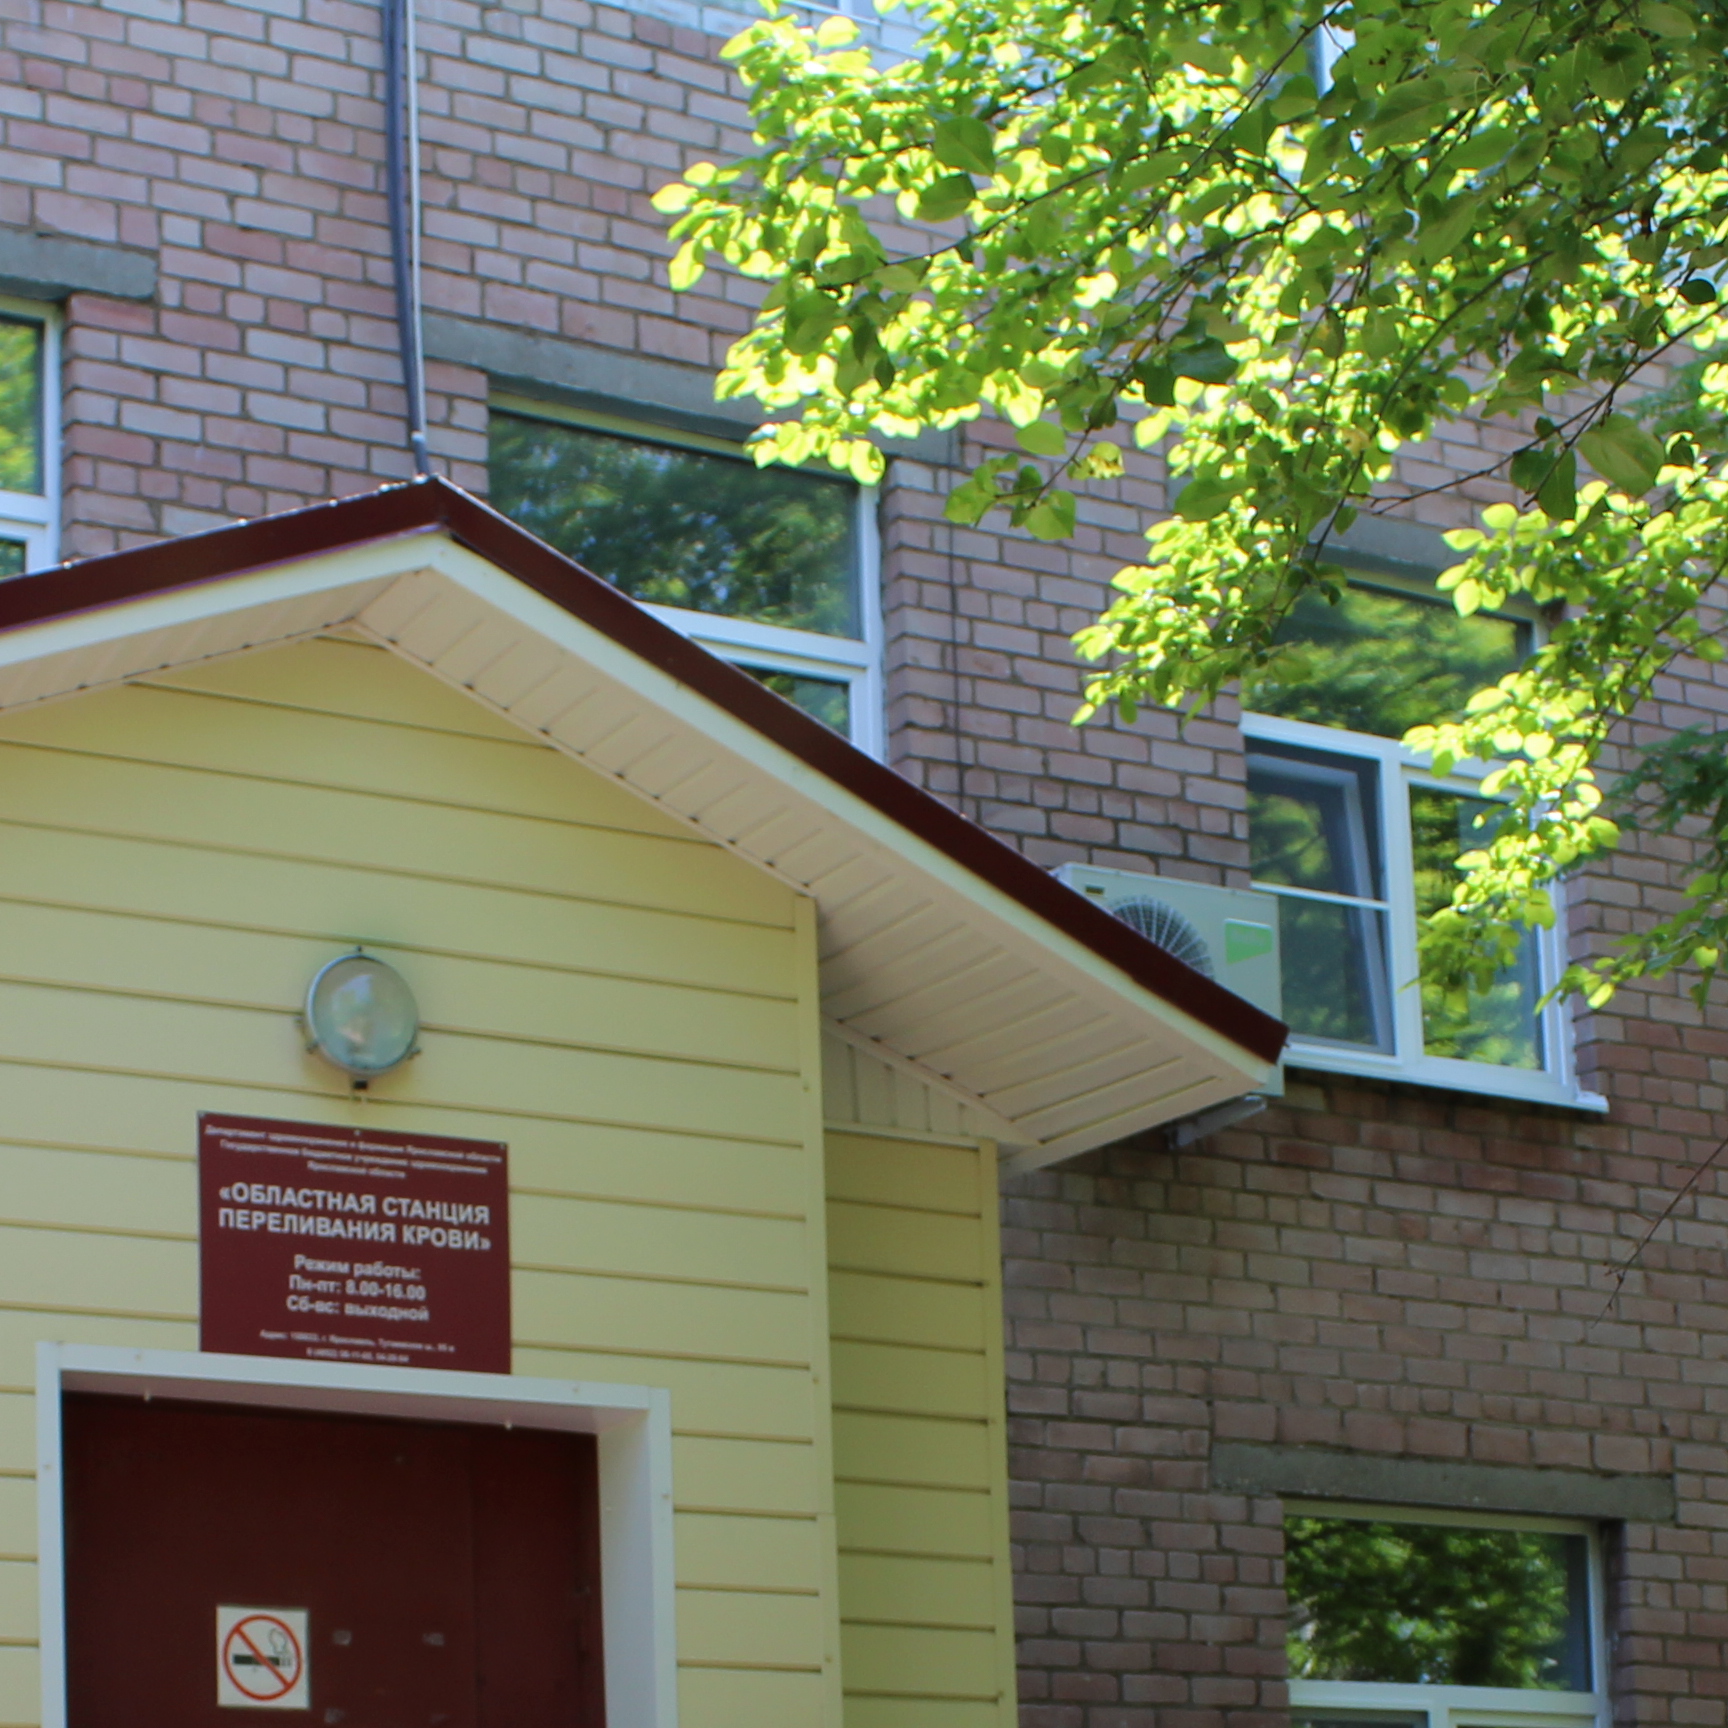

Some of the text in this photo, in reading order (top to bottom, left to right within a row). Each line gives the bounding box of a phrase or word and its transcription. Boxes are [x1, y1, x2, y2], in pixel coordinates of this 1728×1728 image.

[219, 1182, 490, 1225] «ОБЛАСТНАЯ СТАНЦИЯ
[219, 1207, 491, 1250] ПЕРЕЛИВАНИЯ КРОВИ»
[293, 1254, 422, 1280] Режим работы:
[289, 1274, 342, 1294] Пн-пт:
[286, 1295, 430, 1322] Сб-вс: выходной
